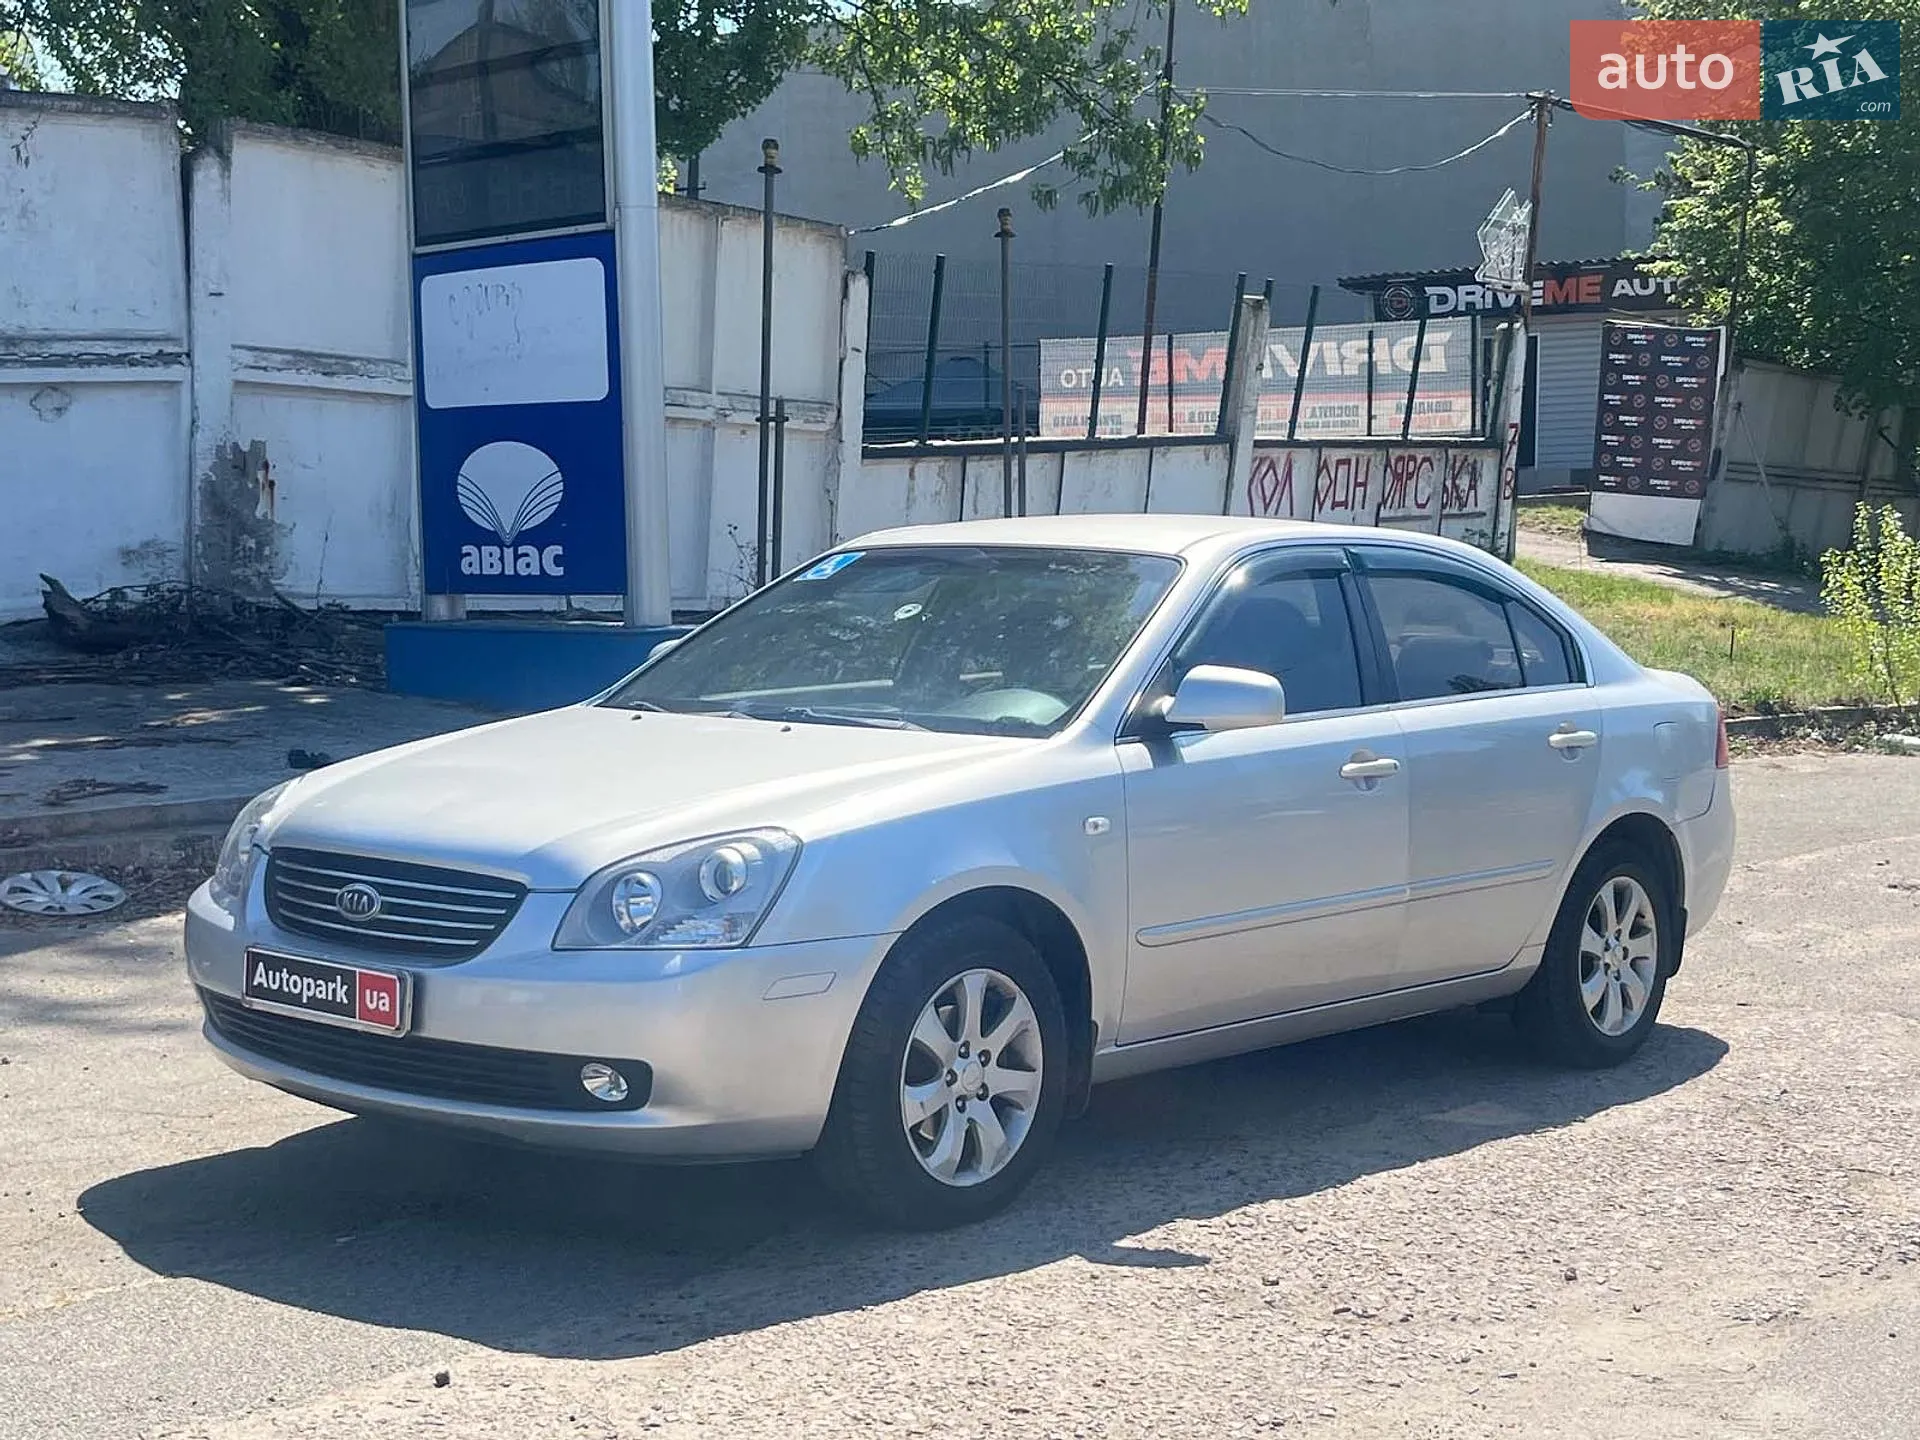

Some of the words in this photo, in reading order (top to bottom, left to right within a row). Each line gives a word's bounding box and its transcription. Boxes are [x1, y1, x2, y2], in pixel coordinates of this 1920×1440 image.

[343, 892, 368, 912] KIA
[253, 961, 348, 1004] Autopark
[365, 988, 390, 1013] ua
